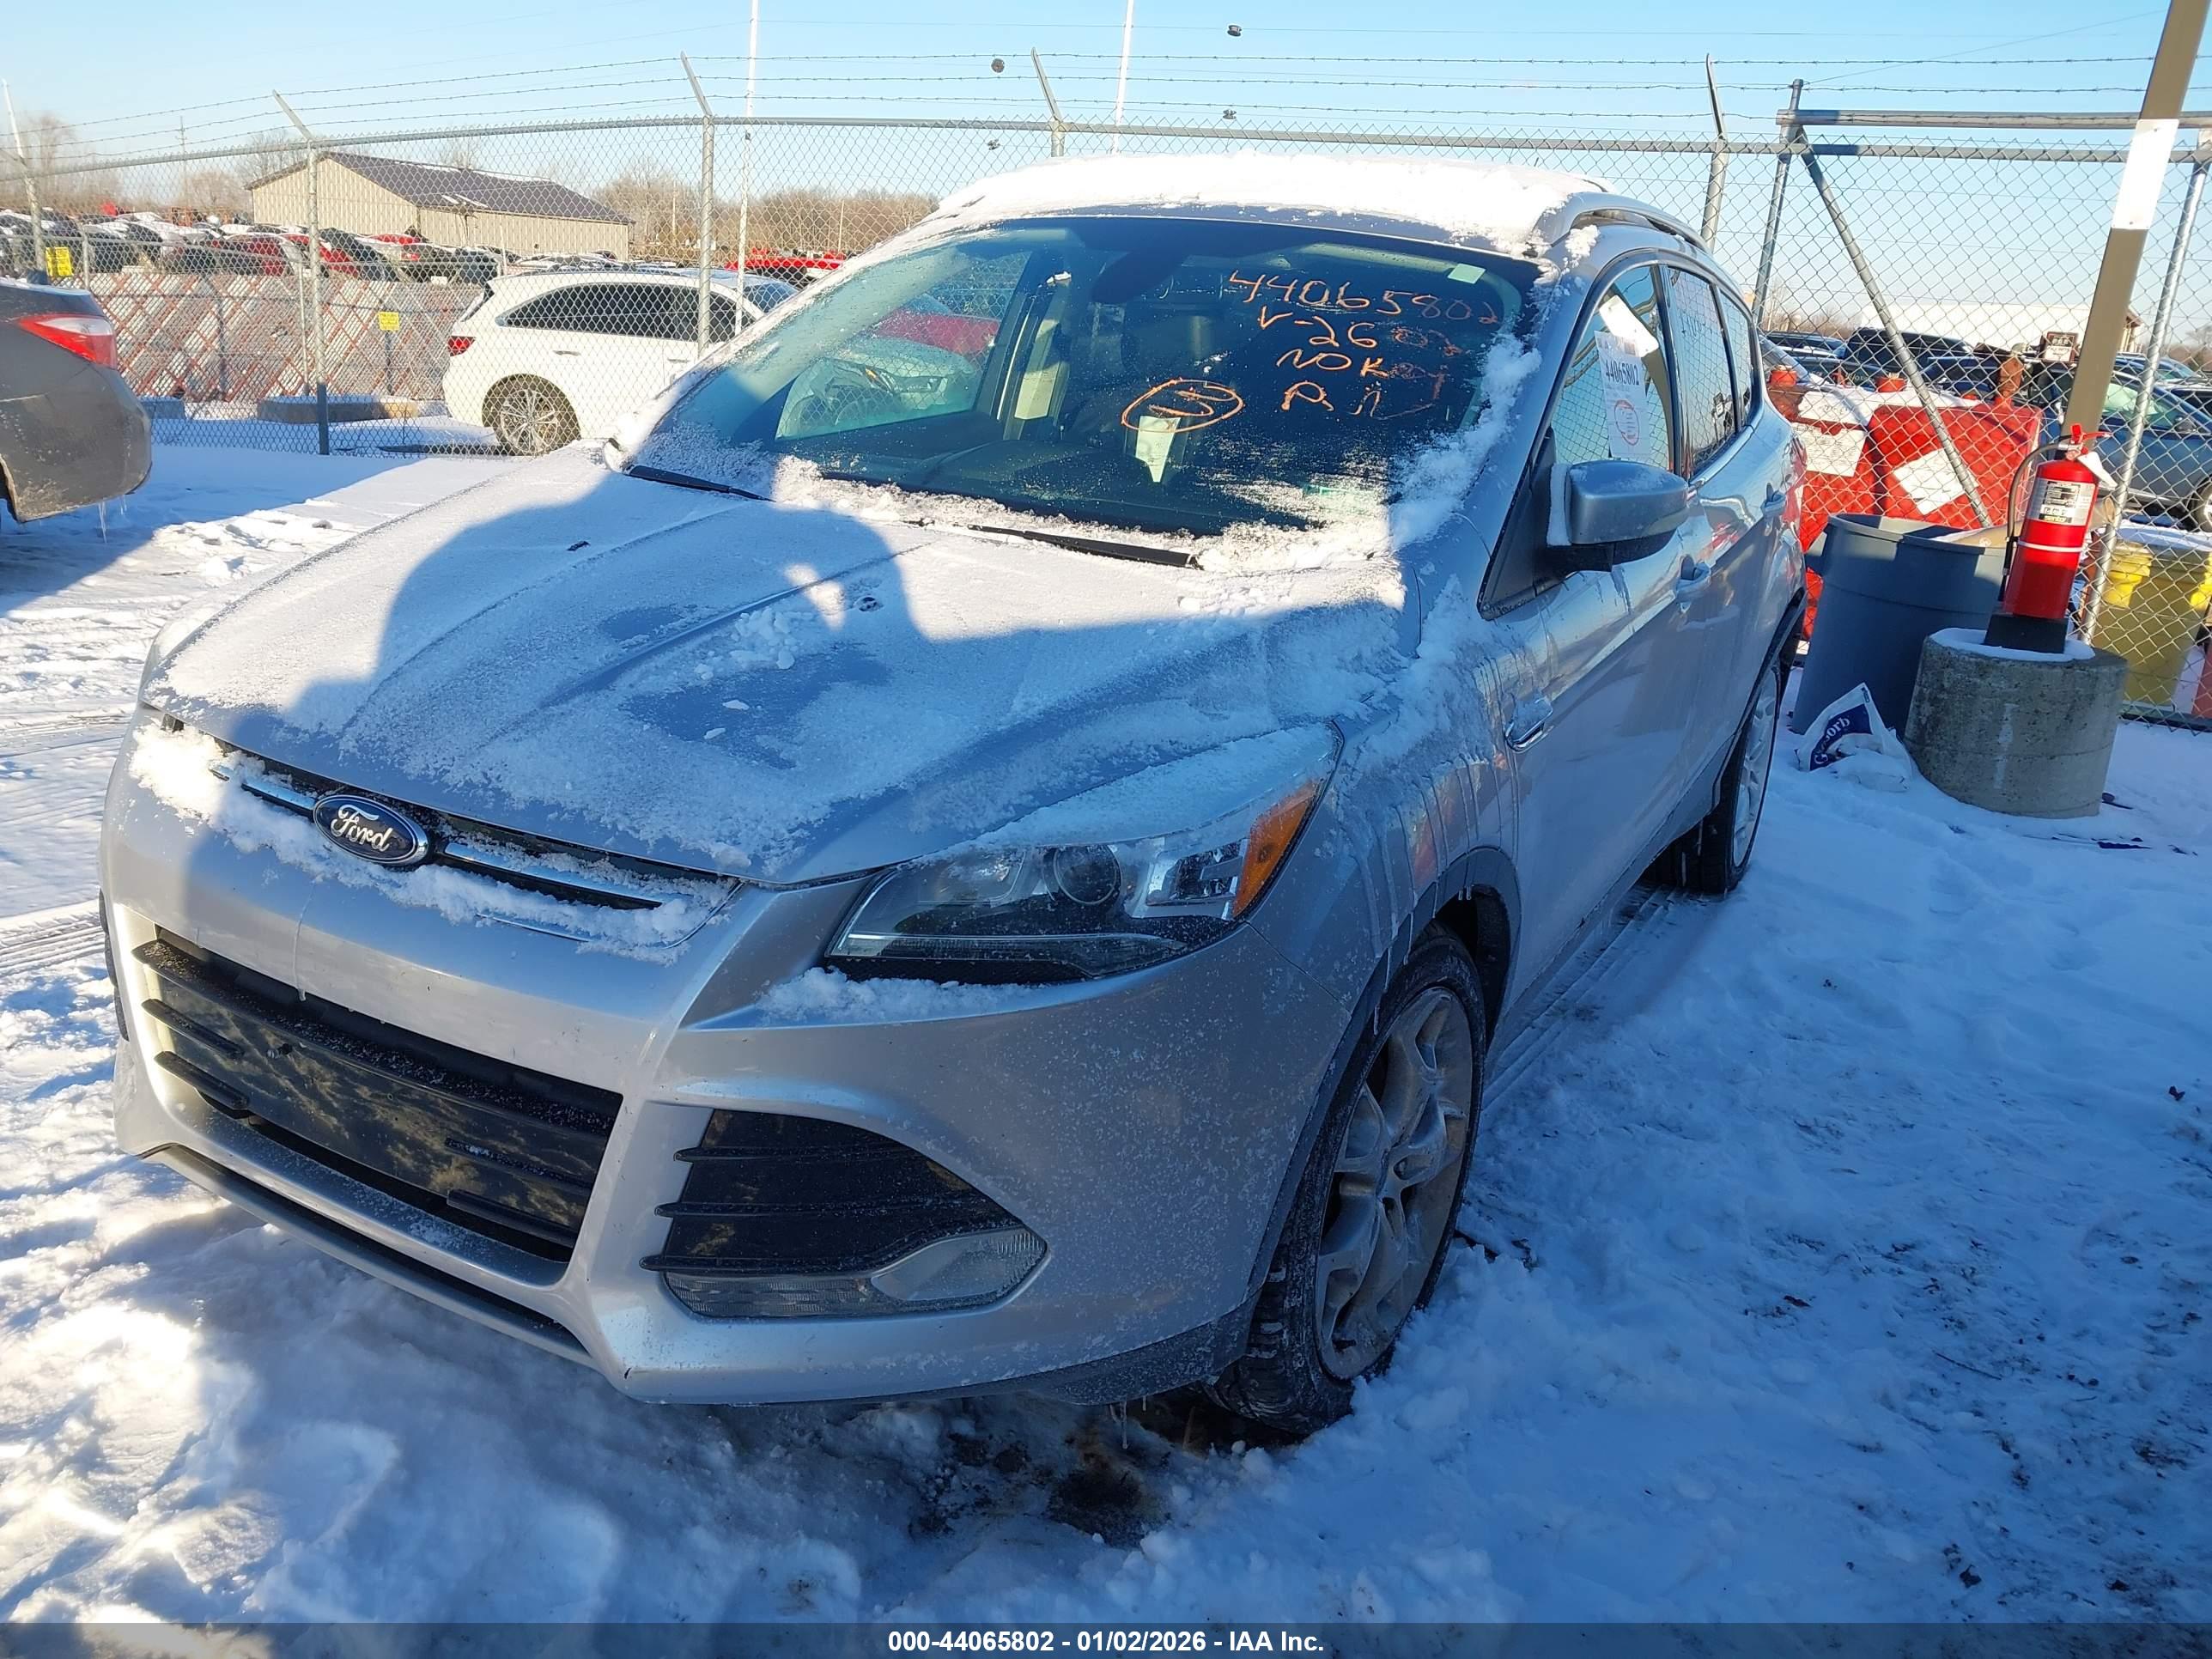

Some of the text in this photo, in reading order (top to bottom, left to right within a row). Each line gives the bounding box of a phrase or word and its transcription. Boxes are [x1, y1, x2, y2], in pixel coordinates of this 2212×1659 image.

[1230, 270, 1499, 325] 44065802
[1276, 349, 1352, 370] NO
[1605, 359, 1641, 386] 44065802
[330, 804, 394, 852] Ford
